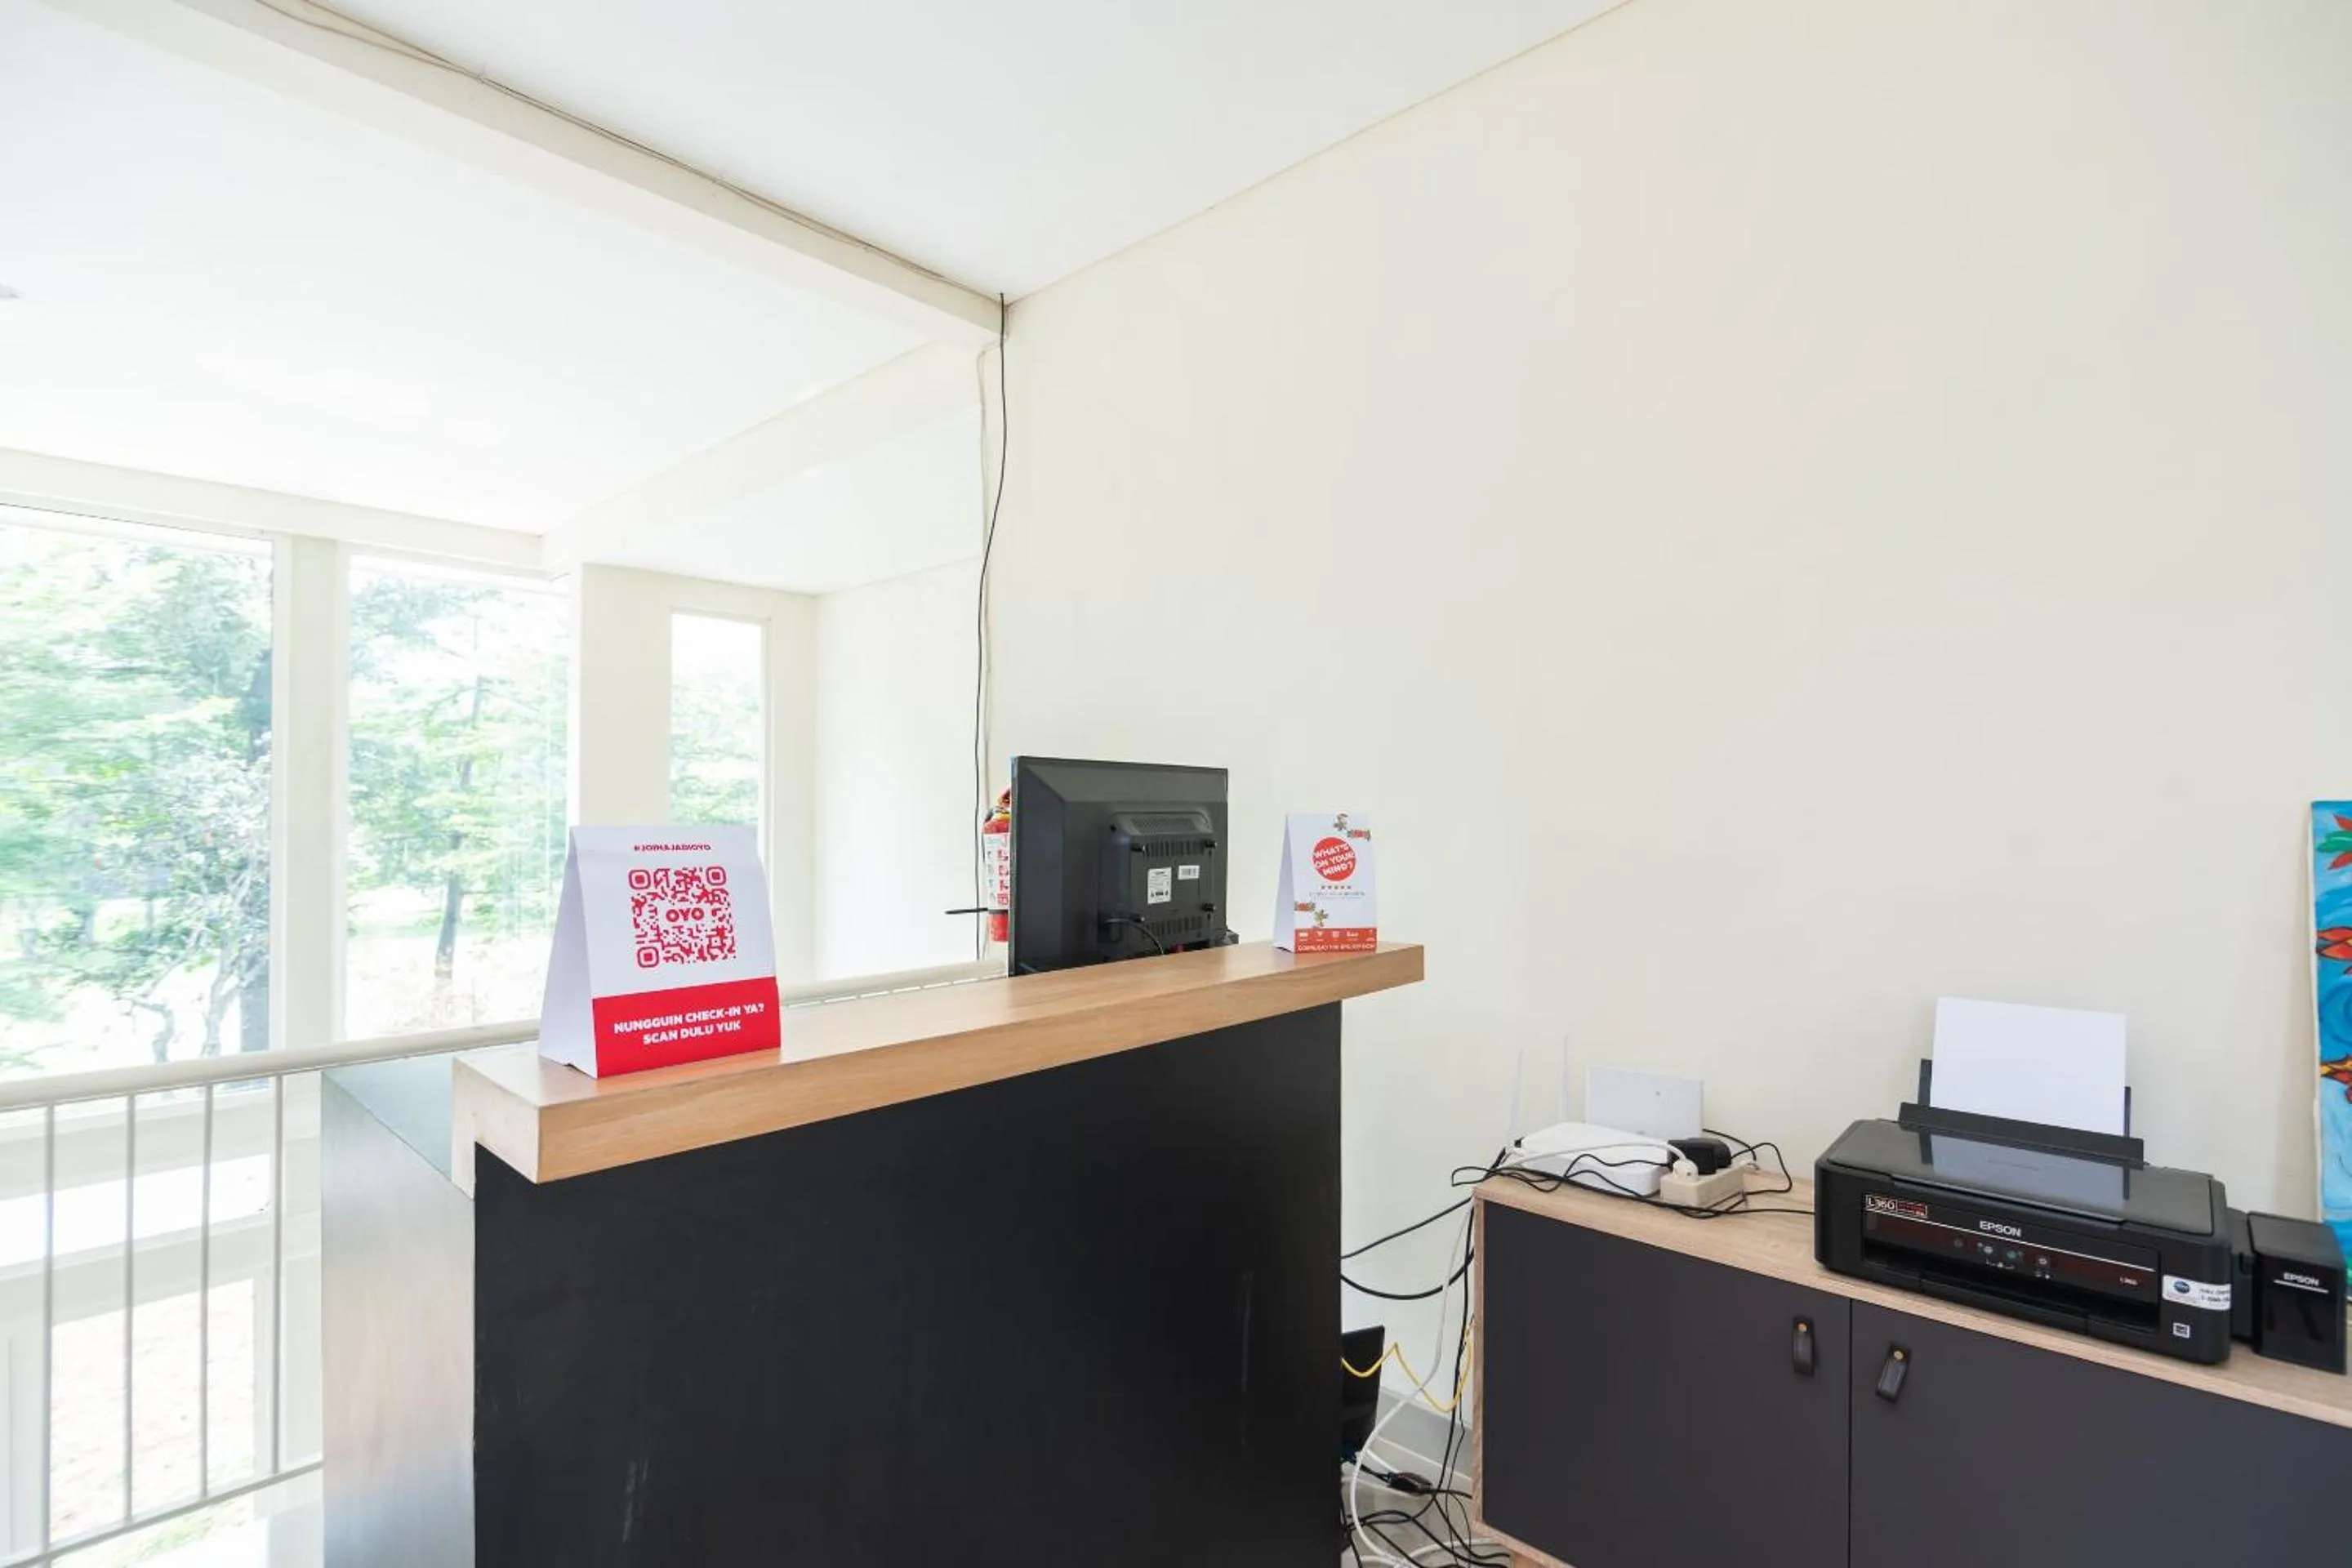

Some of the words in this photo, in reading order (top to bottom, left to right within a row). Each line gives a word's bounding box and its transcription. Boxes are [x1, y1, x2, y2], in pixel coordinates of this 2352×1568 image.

[1314, 843, 1349, 858] WHAT'S
[1315, 858, 1329, 867] ON
[665, 907, 705, 923] OYO
[614, 1014, 683, 1034] NUNGGUIN
[685, 1005, 742, 1023] CHECK-IN
[743, 1003, 765, 1014] YA?
[643, 1031, 679, 1045] SCAN
[680, 1024, 714, 1038] DULU
[715, 1021, 742, 1033] YUK
[1979, 1220, 2022, 1237] EPSON
[2283, 1272, 2319, 1286] EPSON
